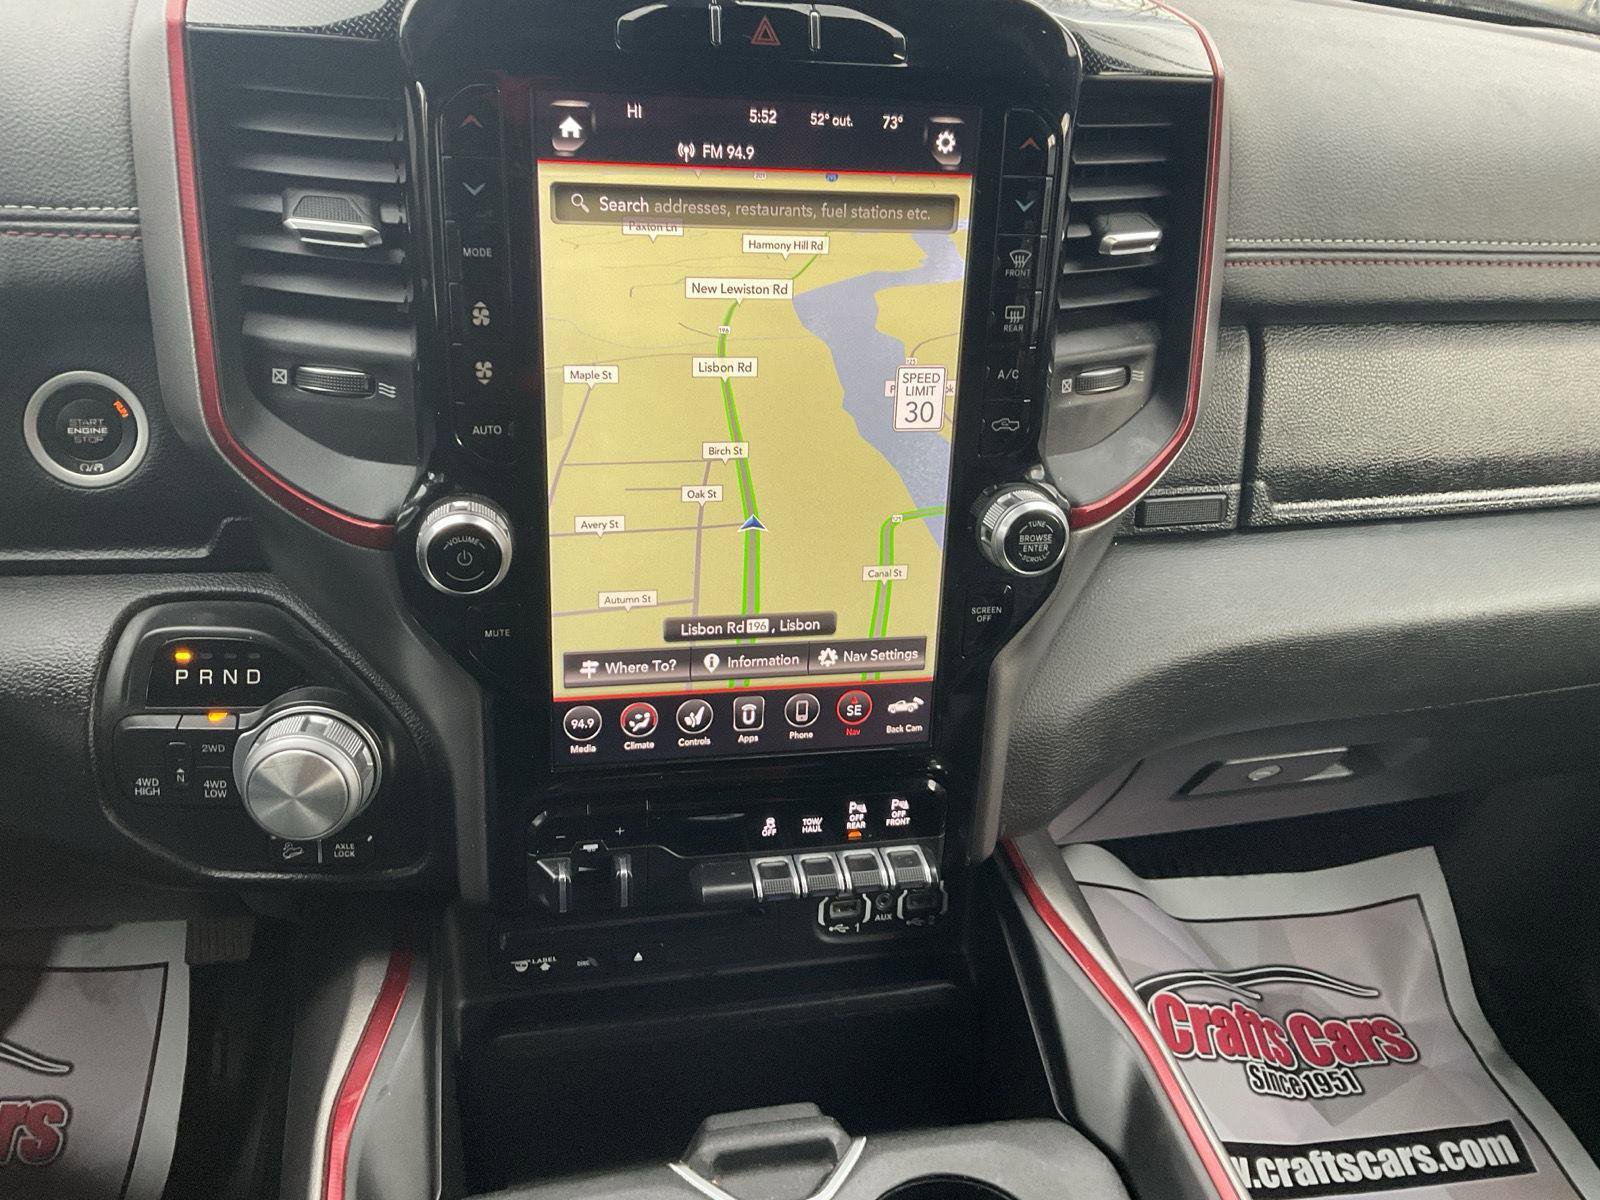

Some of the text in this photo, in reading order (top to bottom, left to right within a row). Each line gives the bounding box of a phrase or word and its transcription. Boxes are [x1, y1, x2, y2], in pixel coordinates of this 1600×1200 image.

[627, 103, 642, 119] HI
[749, 109, 777, 125] 5:52
[882, 115, 904, 130] 73°
[702, 144, 755, 160] FM 94.9
[600, 196, 931, 221] Search addresses, restaurants, fuel stations etc.
[748, 240, 824, 252] Harmony Hill Rd
[463, 248, 492, 257] MODE
[1005, 269, 1031, 277] FRONT
[691, 282, 788, 296] New Lewiston Rd
[1003, 324, 1024, 332] REAR
[698, 362, 752, 373] Lisbon Rd
[570, 370, 612, 382] Maple St
[902, 373, 941, 384] SPEED
[997, 368, 1020, 380] A/C
[905, 386, 936, 397] LIMIT
[904, 401, 934, 423] 30
[69, 418, 105, 426] START
[67, 427, 108, 435] ENGINE
[472, 425, 502, 435] AUTO
[708, 446, 742, 456] Birch St
[687, 489, 717, 499] Oak St
[581, 520, 619, 531] Avery St
[1028, 520, 1047, 528] TUNE
[447, 535, 480, 546] VOLUME
[1019, 533, 1053, 542] BROWSE
[1023, 544, 1049, 553] ENTER
[867, 568, 902, 578] Canal St
[604, 595, 640, 605] Autumn
[971, 606, 1002, 615] SCREEN
[681, 623, 723, 636] Lisbon
[727, 621, 745, 634] Rd
[747, 620, 768, 632] 196
[780, 619, 820, 632] Lisbon
[484, 629, 510, 638] MUTE
[843, 648, 919, 663] Nav Settings
[605, 658, 677, 674] Where To?
[728, 654, 800, 668] Information
[846, 705, 863, 717] SE
[570, 718, 595, 730] 94.9
[886, 723, 923, 734] Back Cam
[789, 731, 814, 740] Phone
[846, 728, 861, 736] Nav
[678, 737, 711, 747] Controls
[737, 734, 759, 744] Apps
[201, 744, 226, 752] 2WD
[570, 744, 597, 753] Media
[623, 741, 655, 750] Climate
[135, 777, 160, 787] 4WD
[203, 779, 227, 789] 4WD
[134, 787, 161, 796] HIGH
[204, 789, 227, 798] LOW
[802, 817, 823, 826] TOW/
[886, 817, 911, 827] FRONT
[761, 828, 777, 837] OFF
[802, 825, 823, 834] HAUL
[874, 913, 893, 922] AUX
[1151, 991, 1419, 1069] Crafts Cars
[1247, 1061, 1365, 1099] Since 1951
